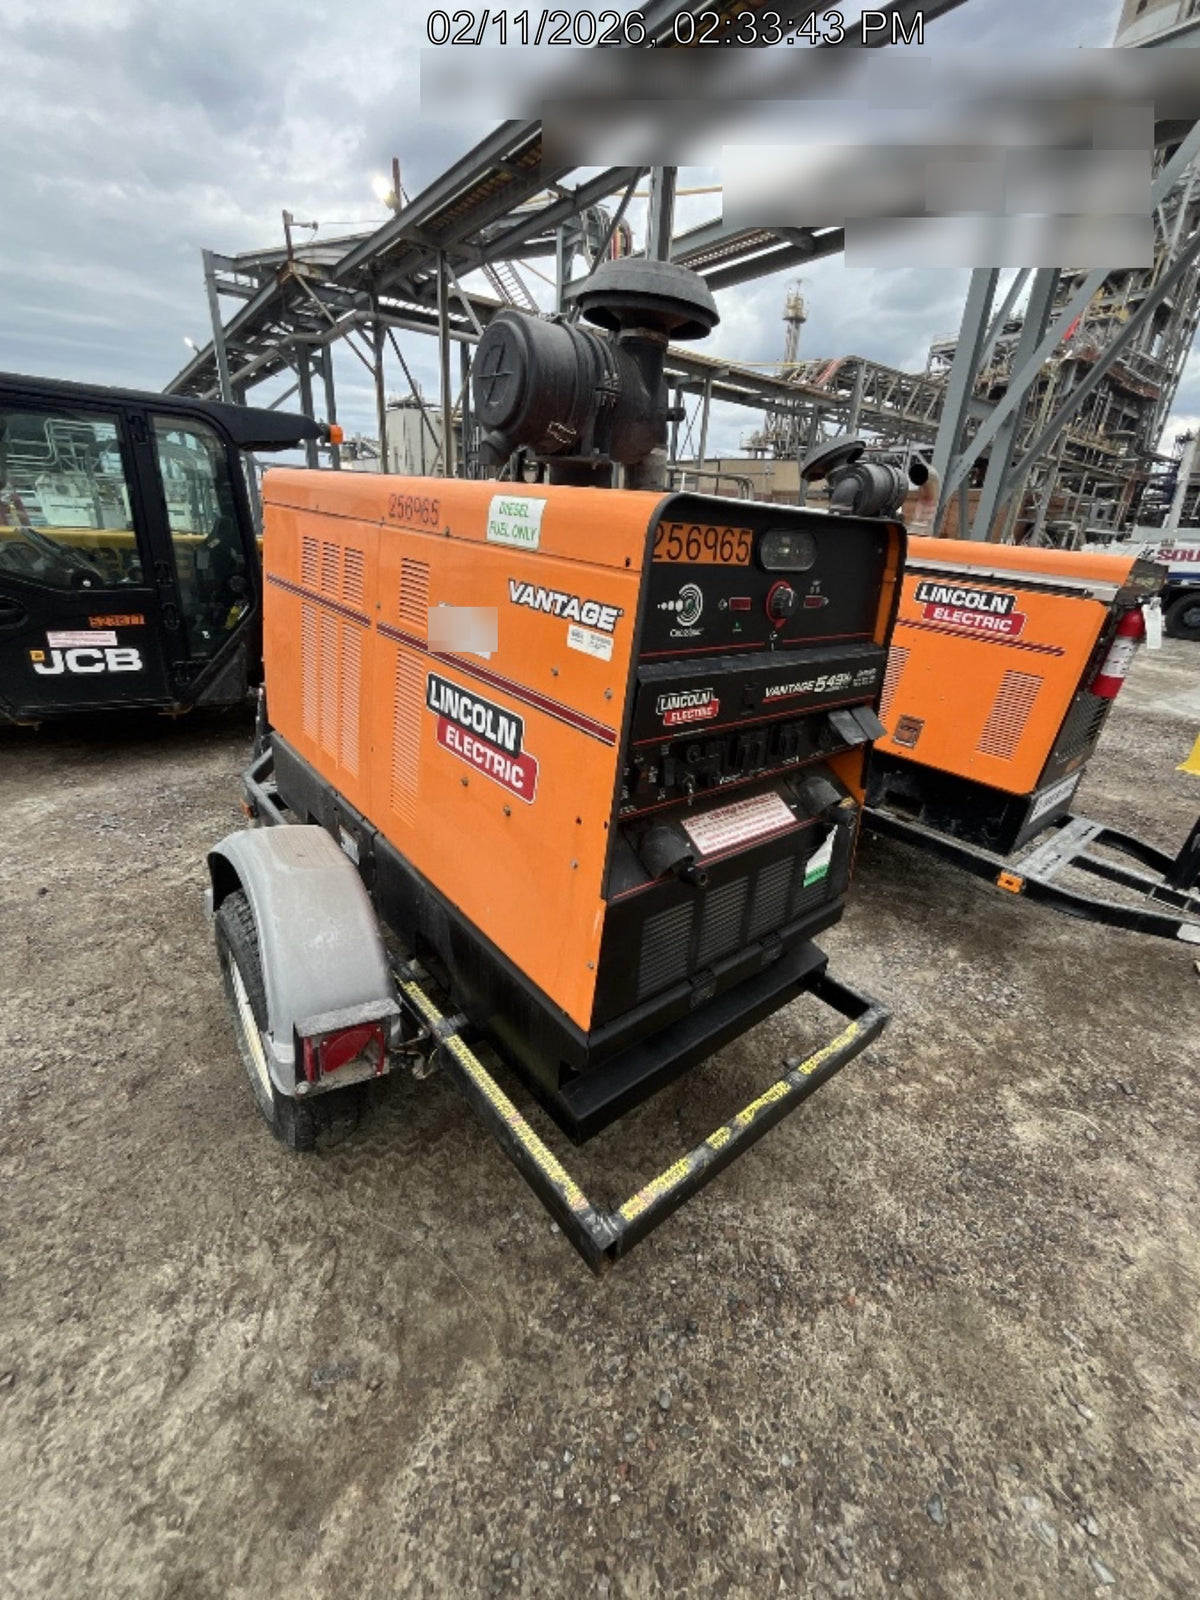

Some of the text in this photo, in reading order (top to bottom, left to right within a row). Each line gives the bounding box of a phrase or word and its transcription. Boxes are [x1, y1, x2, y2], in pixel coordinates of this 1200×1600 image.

[389, 493, 440, 525] 256965
[498, 501, 529, 518] DIESEL
[489, 520, 538, 541] FUEL ONLY
[653, 522, 751, 563] 256965
[509, 578, 617, 633] VANTAGE
[919, 583, 1009, 614] LINCOLN
[933, 606, 1013, 632] ELECTRIC
[32, 648, 143, 675] JCB
[660, 691, 711, 710] LINCOLN
[765, 680, 815, 697] VANTAGE
[429, 680, 517, 751] LINCOLN
[671, 706, 713, 722] ELECTRIC
[445, 724, 525, 789] ELECTRIC
